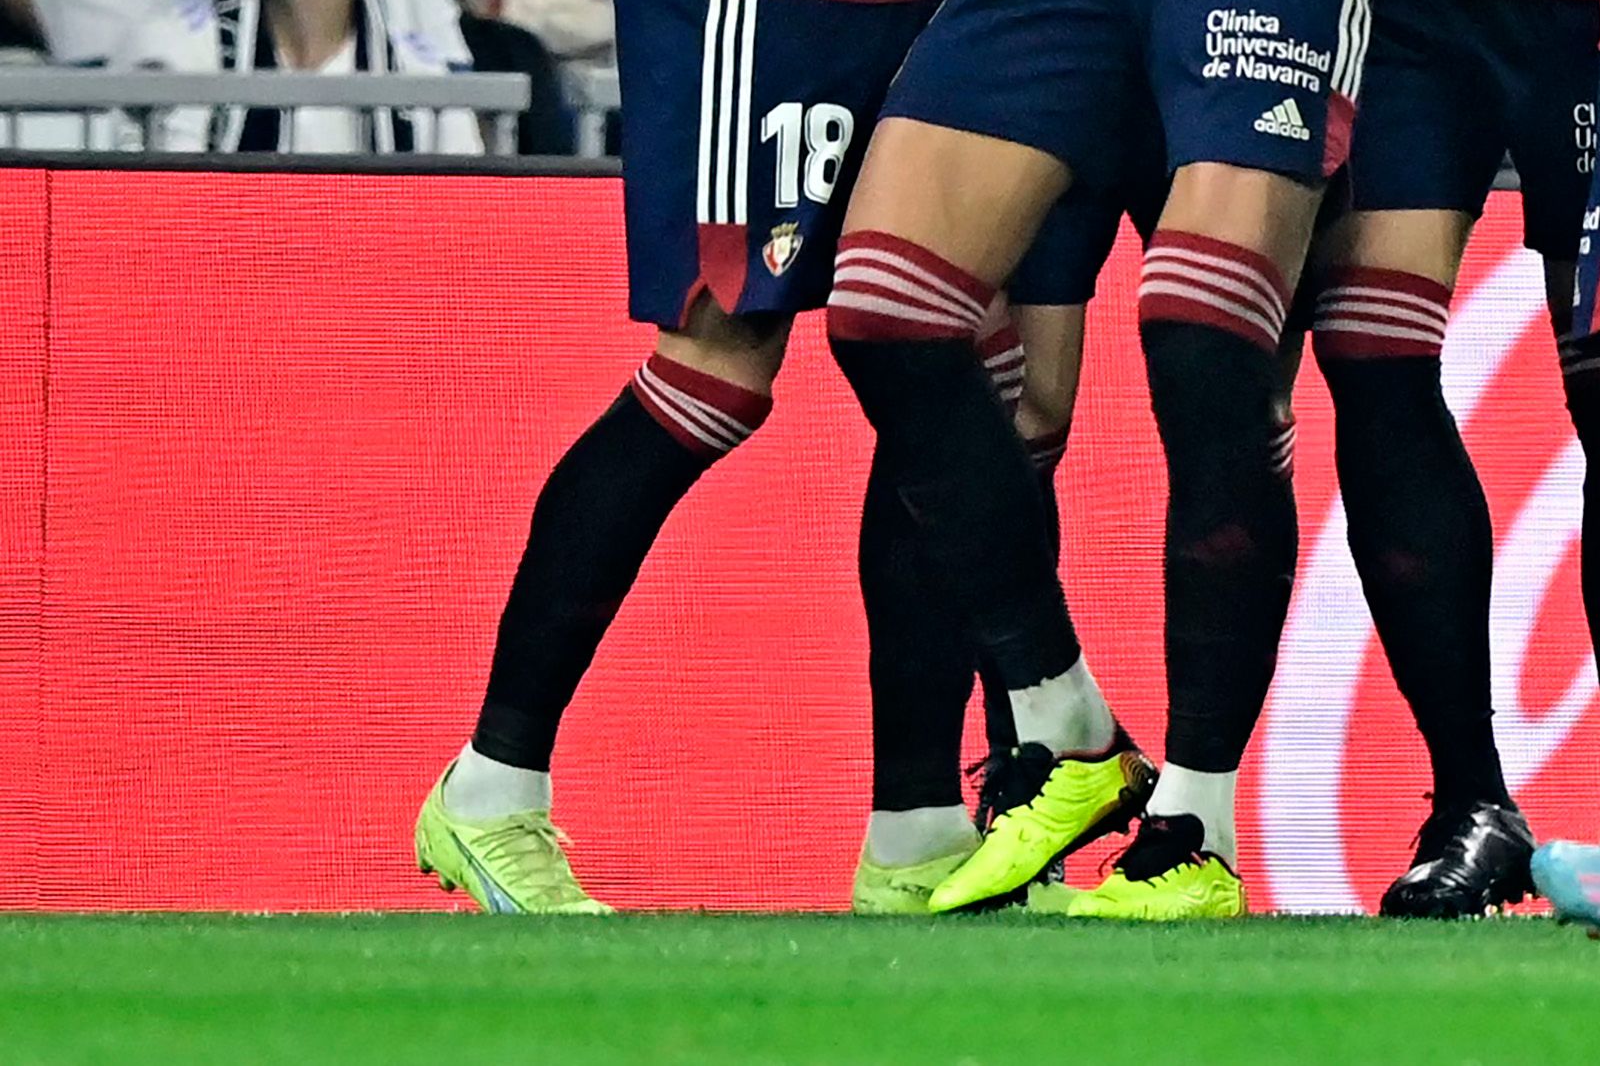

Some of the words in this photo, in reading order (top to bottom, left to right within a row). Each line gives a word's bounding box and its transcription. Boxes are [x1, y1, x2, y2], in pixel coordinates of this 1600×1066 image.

[1205, 32, 1331, 73] Universidad
[1202, 56, 1231, 79] de
[1235, 55, 1320, 93] Navarra
[1253, 118, 1310, 141] adidas
[761, 102, 855, 208] 18
